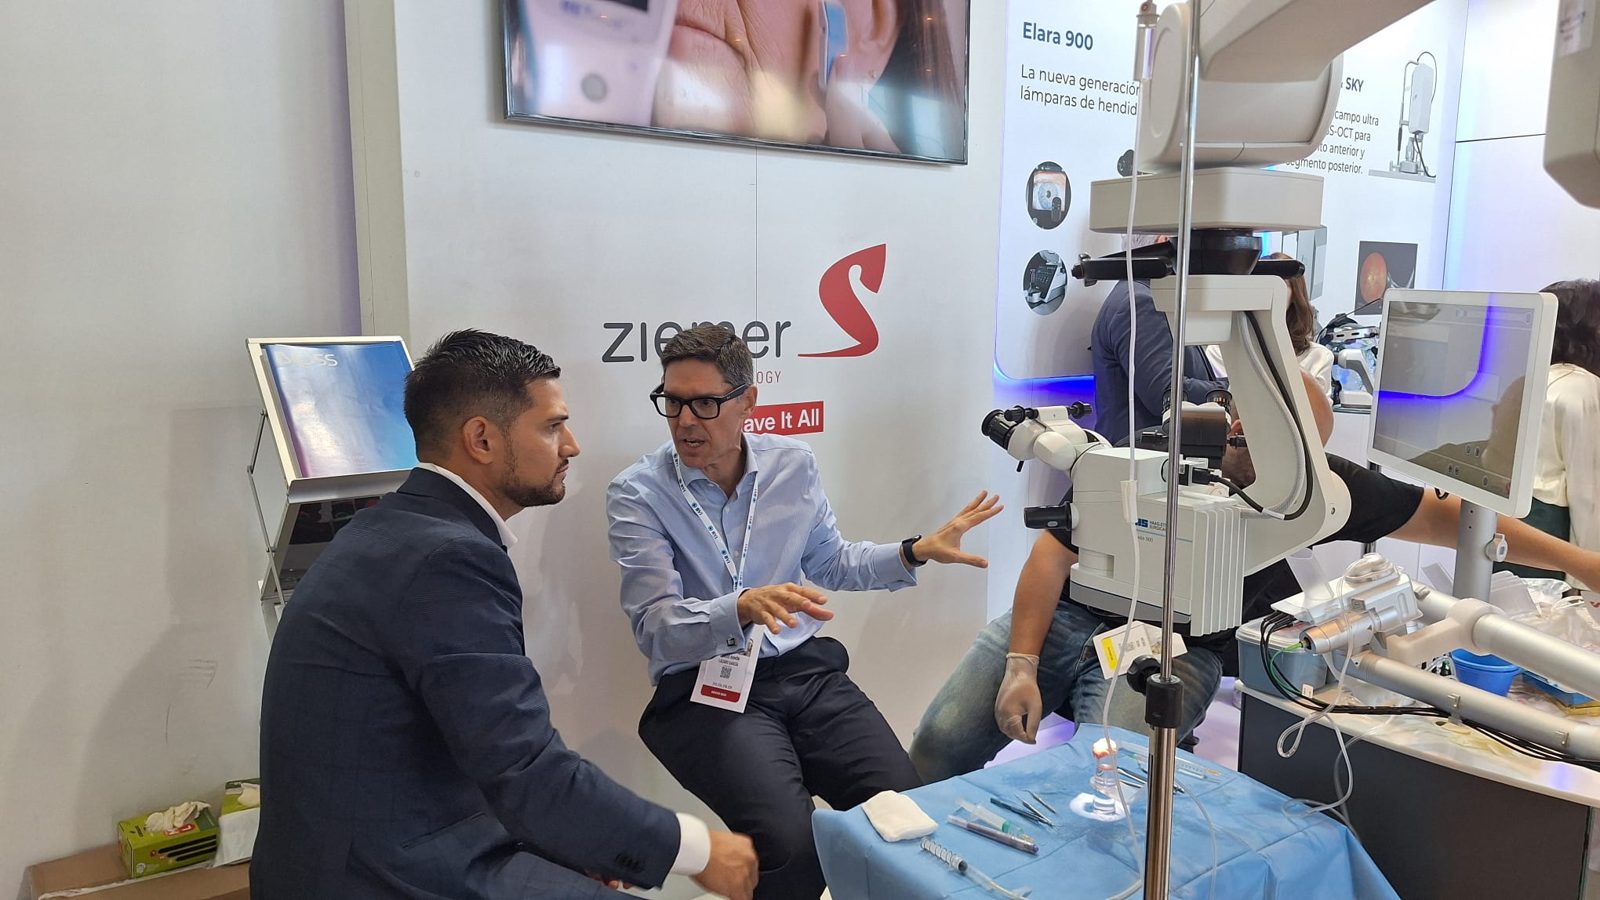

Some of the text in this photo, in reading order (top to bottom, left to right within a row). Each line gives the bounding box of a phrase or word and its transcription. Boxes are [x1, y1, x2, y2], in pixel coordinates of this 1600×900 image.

[1023, 21, 1093, 50] Elara 900
[1021, 63, 1035, 80] La
[1039, 69, 1076, 86] nueva
[1345, 77, 1364, 93] SKY
[1020, 85, 1138, 115] lámparas de hendid
[1334, 110, 1379, 126] campo ultra
[1326, 125, 1371, 141] S-OCT para
[1329, 144, 1359, 157] anterior
[1359, 149, 1366, 160] y
[743, 408, 820, 433] ave It All
